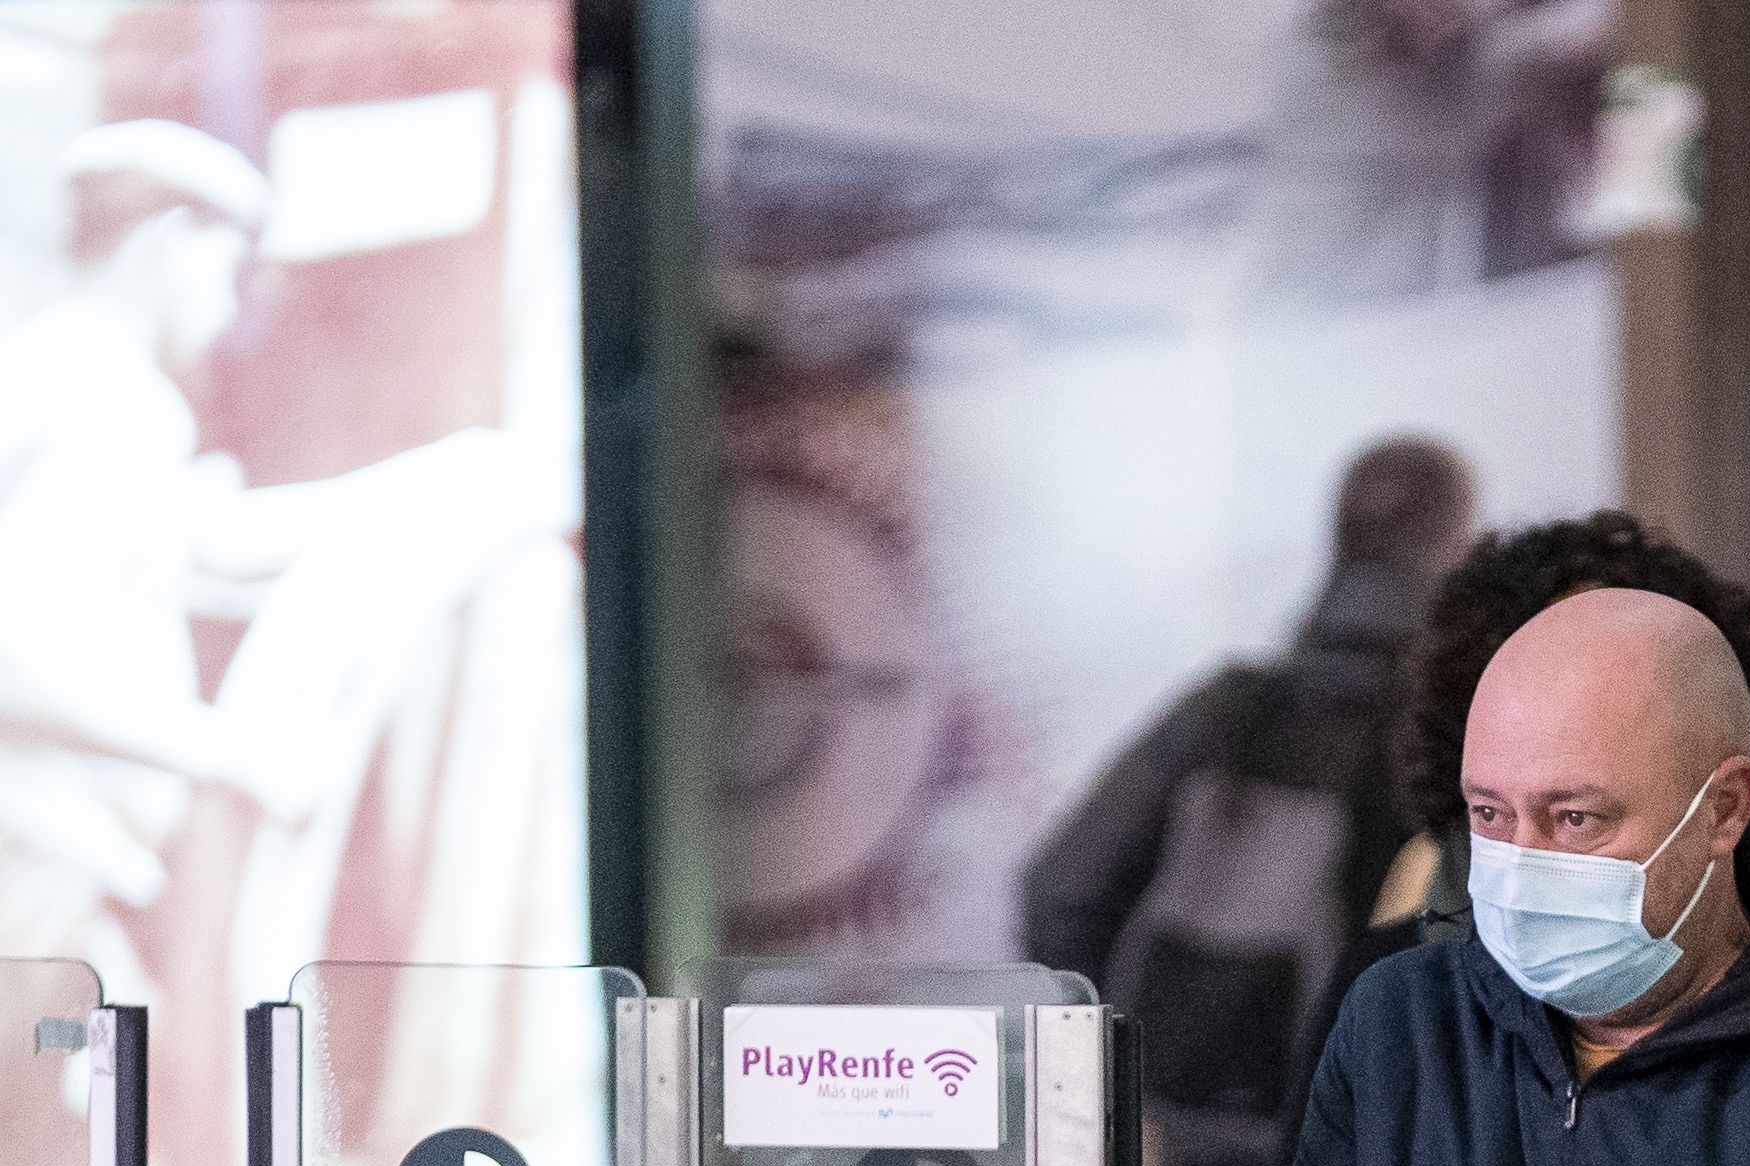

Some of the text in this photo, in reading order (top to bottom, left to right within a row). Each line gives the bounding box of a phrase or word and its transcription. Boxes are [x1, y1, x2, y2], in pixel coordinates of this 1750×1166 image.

[742, 1046, 914, 1085] PlayRenfe
[851, 1087, 878, 1101] que
[884, 1083, 910, 1099] wifi
